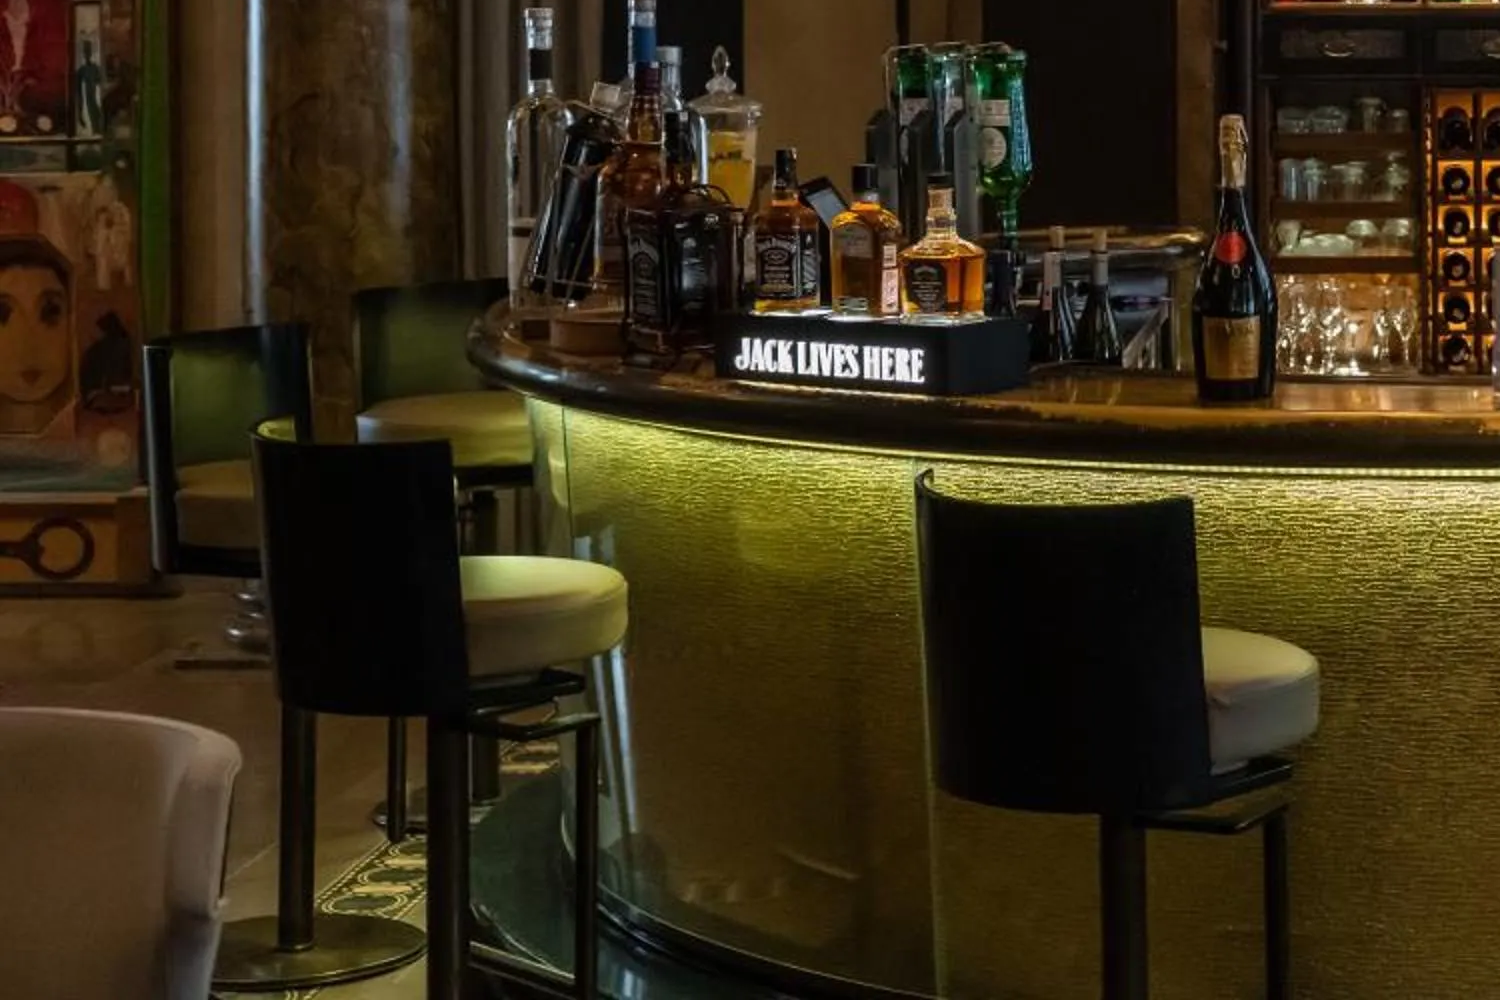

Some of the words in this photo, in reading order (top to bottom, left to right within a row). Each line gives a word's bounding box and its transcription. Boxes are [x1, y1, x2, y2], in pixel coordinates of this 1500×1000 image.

[734, 337, 795, 373] JACK
[796, 341, 860, 379] LIVES
[862, 345, 926, 384] HERE
